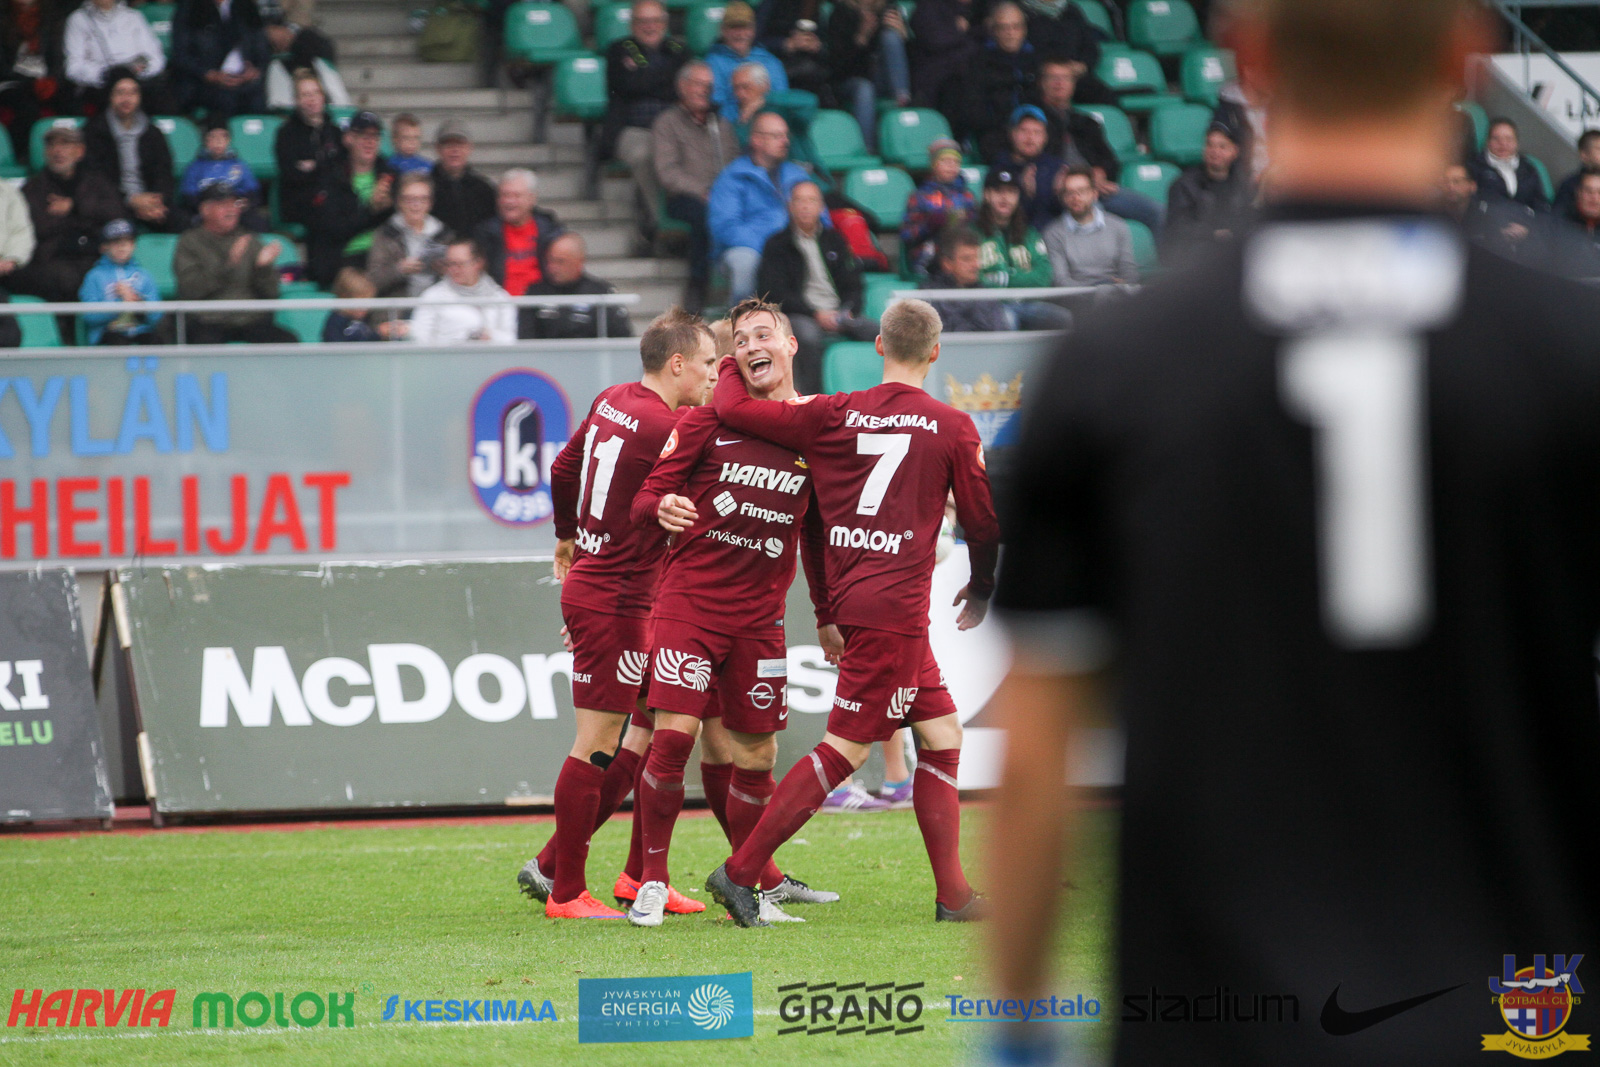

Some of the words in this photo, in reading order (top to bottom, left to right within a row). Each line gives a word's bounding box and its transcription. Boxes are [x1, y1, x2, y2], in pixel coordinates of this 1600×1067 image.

[857, 414, 938, 434] KESKIMAA
[577, 423, 625, 521] 11
[718, 462, 806, 495] HARVIA
[856, 432, 912, 516] 7
[0, 472, 352, 559] HEILIJAT
[739, 502, 794, 525] Fimpec
[705, 529, 762, 551] JYVÄSKYLÄ
